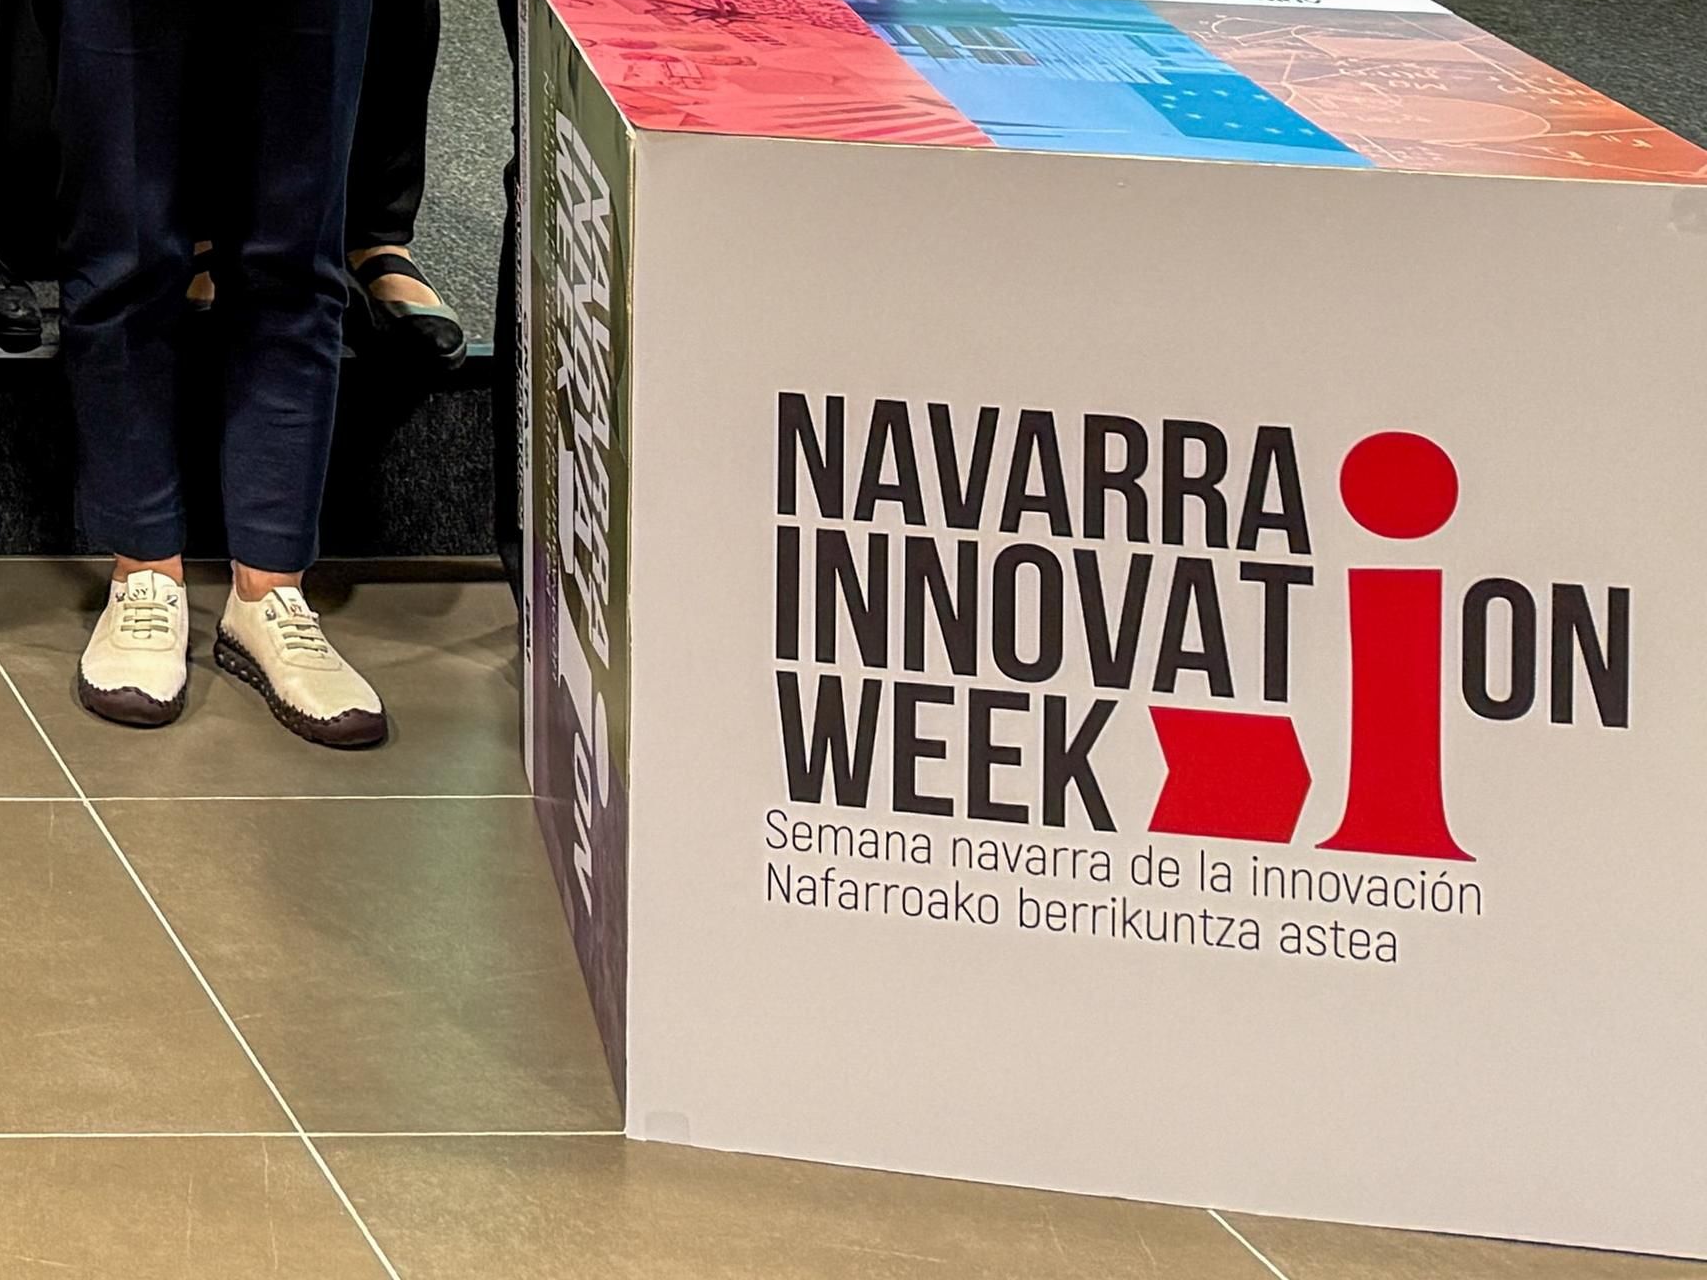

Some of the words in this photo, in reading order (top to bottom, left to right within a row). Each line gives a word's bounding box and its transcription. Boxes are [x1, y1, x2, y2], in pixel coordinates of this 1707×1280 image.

[556, 108, 575, 422] WEEK
[591, 158, 610, 670] NAVARRA
[776, 391, 1313, 556] NAVARRA
[776, 669, 1119, 833] WEEK
[765, 808, 933, 866] Semana
[951, 835, 1111, 883] navarra
[1130, 846, 1181, 889] de
[1199, 849, 1234, 893] la
[1250, 854, 1483, 916] innovación
[766, 862, 1000, 926] Nafarroako
[1019, 885, 1260, 951] berrikuntza
[1279, 919, 1399, 965] astea
